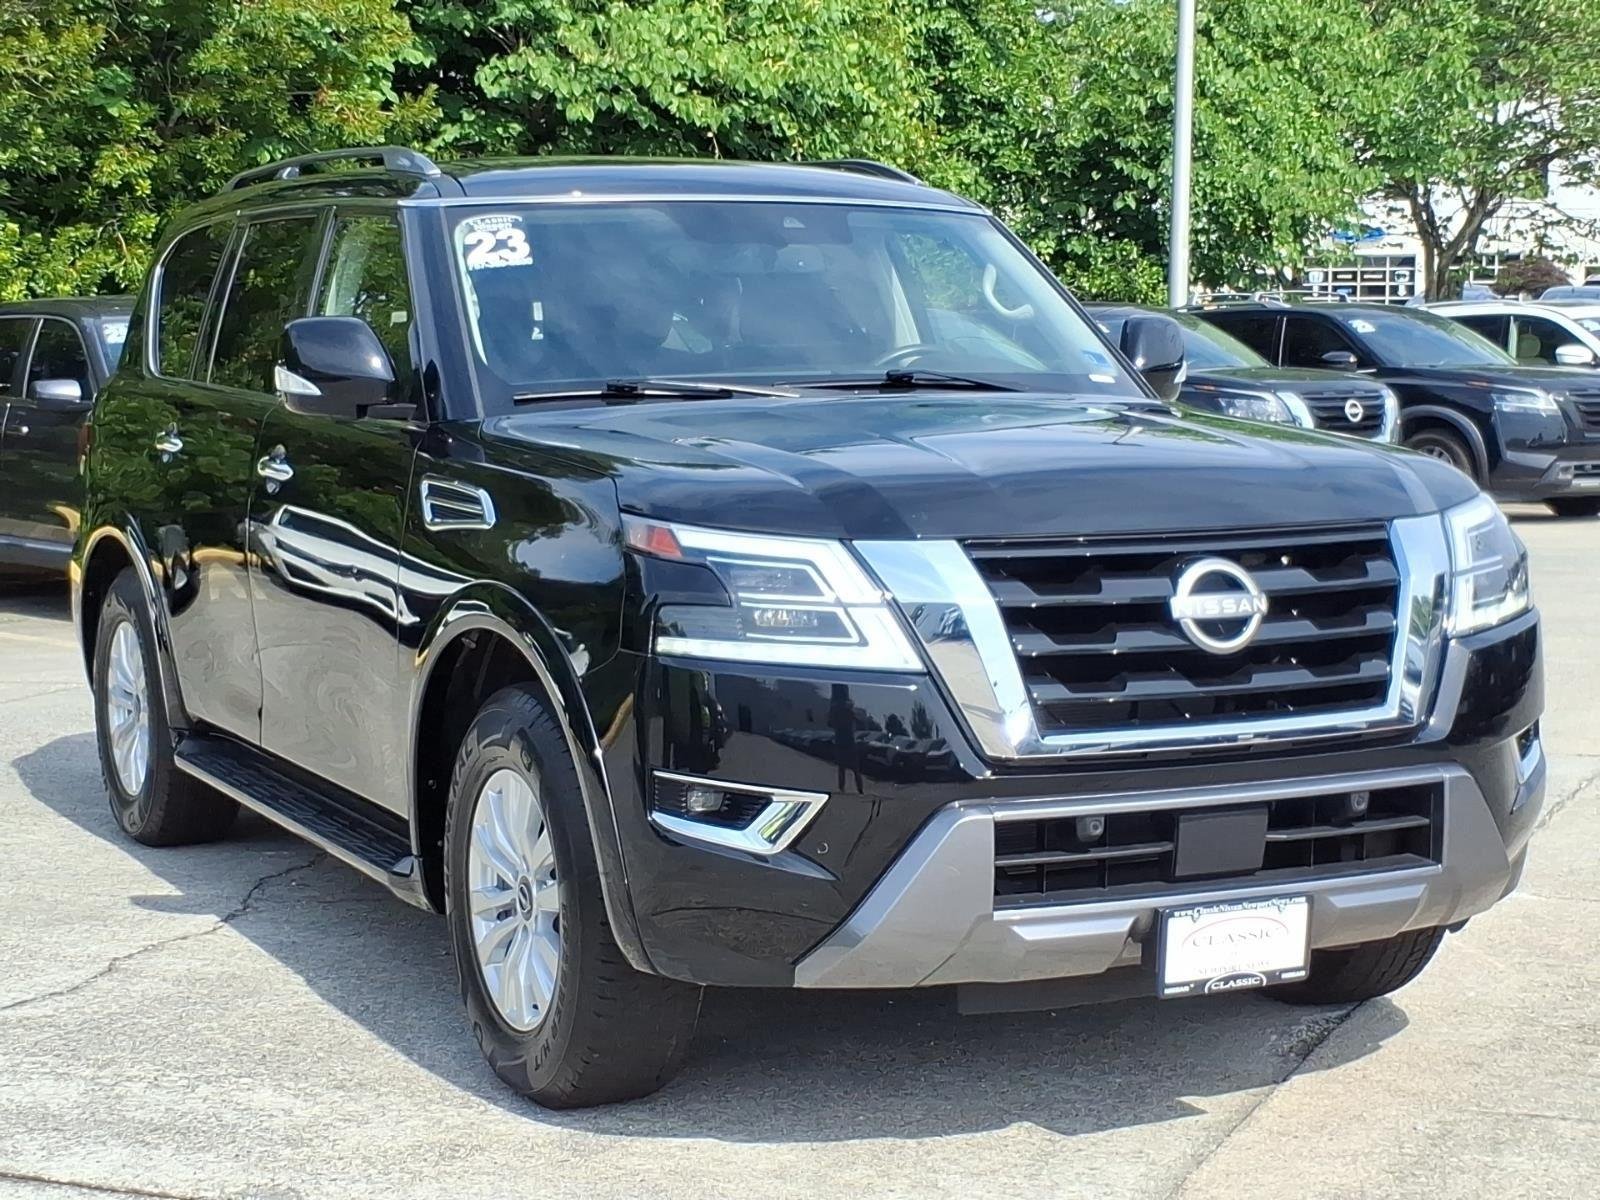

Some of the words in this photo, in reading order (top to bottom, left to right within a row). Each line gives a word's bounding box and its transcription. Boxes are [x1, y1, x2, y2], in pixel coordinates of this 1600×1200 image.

[464, 228, 531, 263] 23
[1173, 591, 1268, 617] NISSAN
[1192, 927, 1274, 947] CLASSIC
[1211, 976, 1261, 990] CLASSIC
